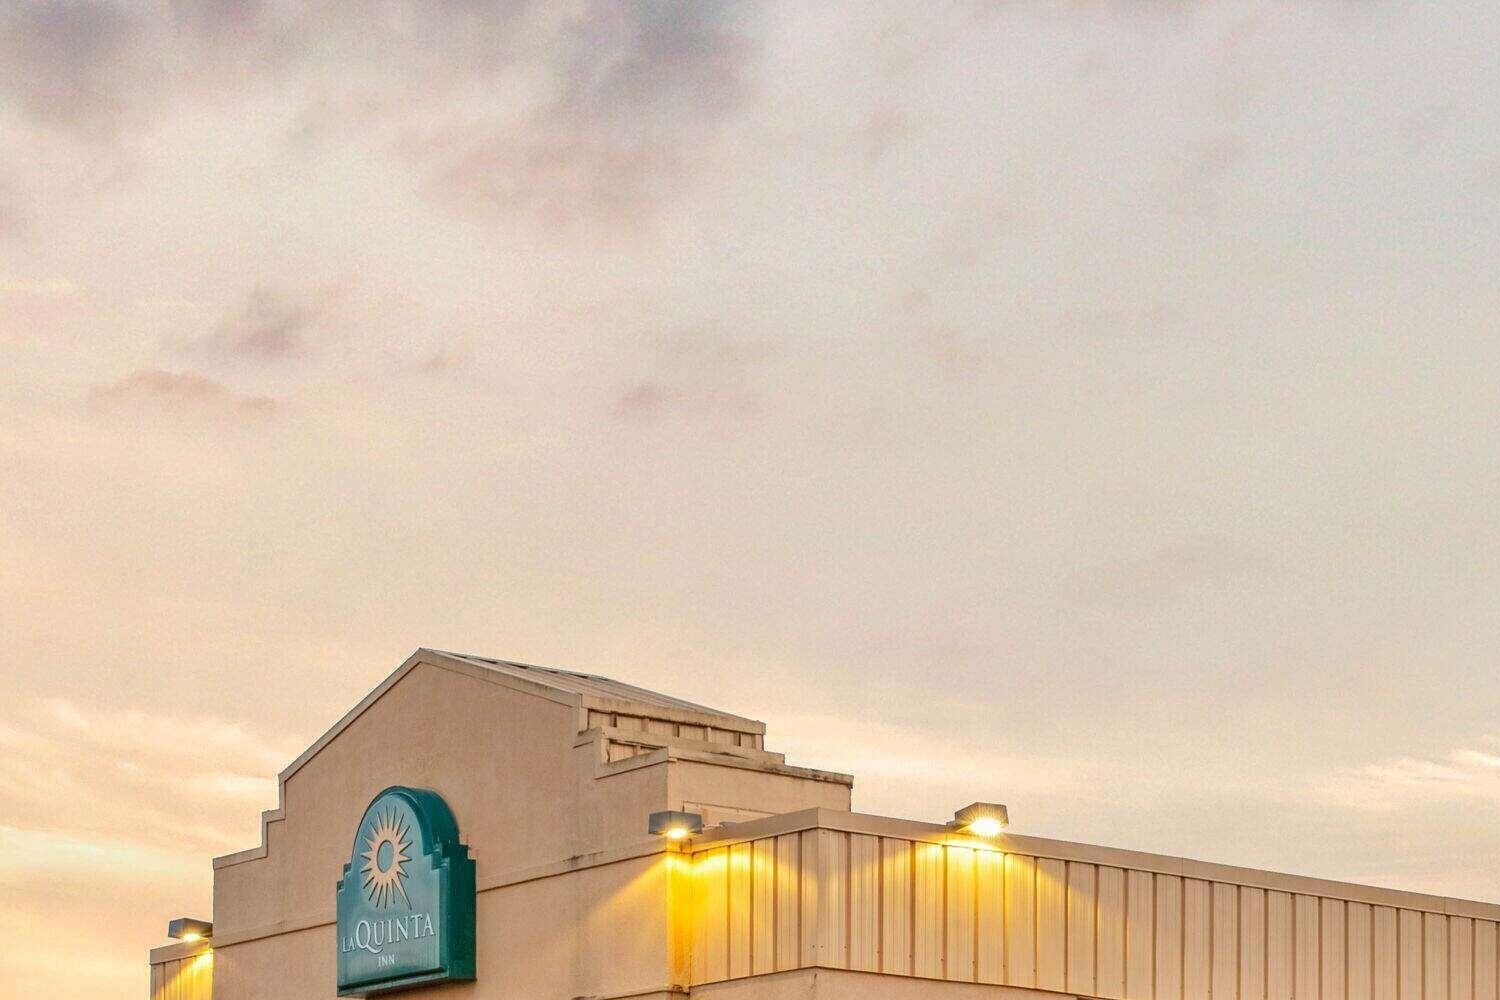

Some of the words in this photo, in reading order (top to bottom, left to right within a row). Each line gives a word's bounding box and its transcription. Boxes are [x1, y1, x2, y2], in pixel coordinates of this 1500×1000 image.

[342, 936, 356, 953] LA
[355, 913, 436, 954] QUINTA
[377, 954, 395, 968] INN
